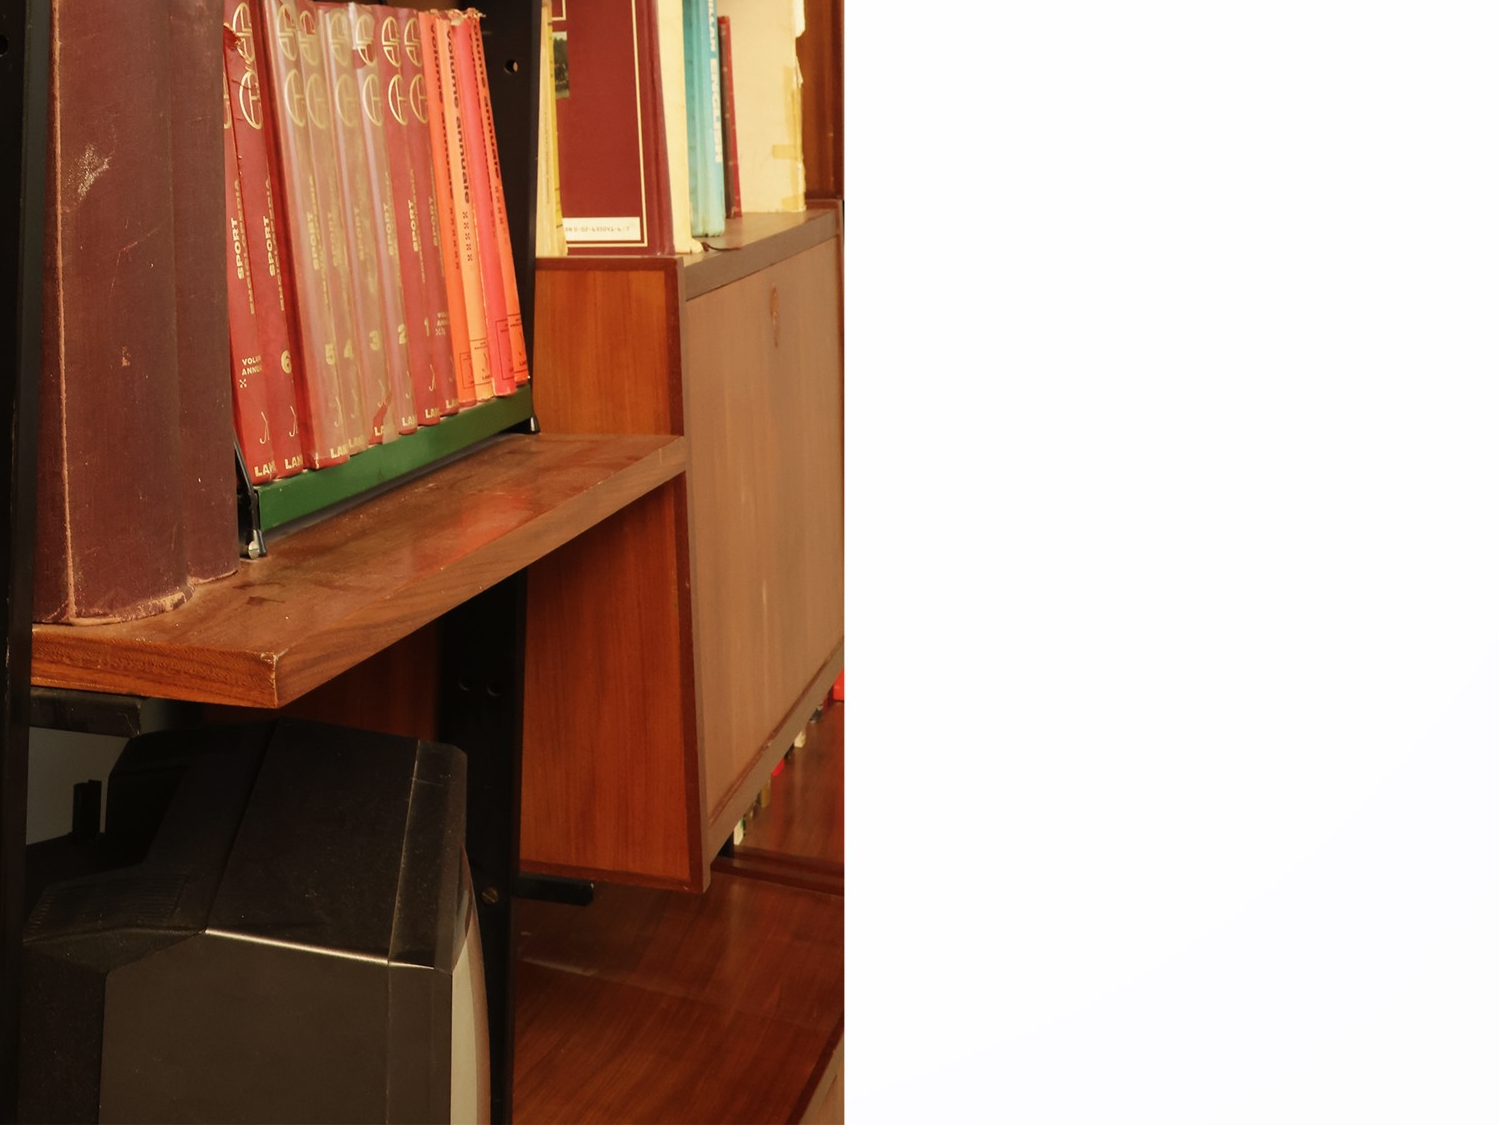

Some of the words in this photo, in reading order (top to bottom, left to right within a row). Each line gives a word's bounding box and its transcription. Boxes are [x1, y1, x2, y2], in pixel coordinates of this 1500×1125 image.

[431, 24, 444, 104] volume
[441, 111, 454, 200] annuale
[447, 30, 459, 109] volume
[456, 116, 469, 204] annuale
[473, 23, 486, 89] olume
[484, 95, 499, 179] annuale
[710, 58, 722, 163] ENGLISH
[231, 217, 245, 280] SPORT
[263, 215, 276, 277] SPORT
[307, 211, 320, 270] SPORT
[383, 202, 395, 256] SPORT
[408, 199, 419, 252] SPORT
[324, 343, 336, 365] 5
[343, 339, 354, 359] 4
[369, 330, 380, 351] 3
[398, 323, 407, 345] 2
[424, 317, 430, 337] 1
[281, 350, 292, 374] 6
